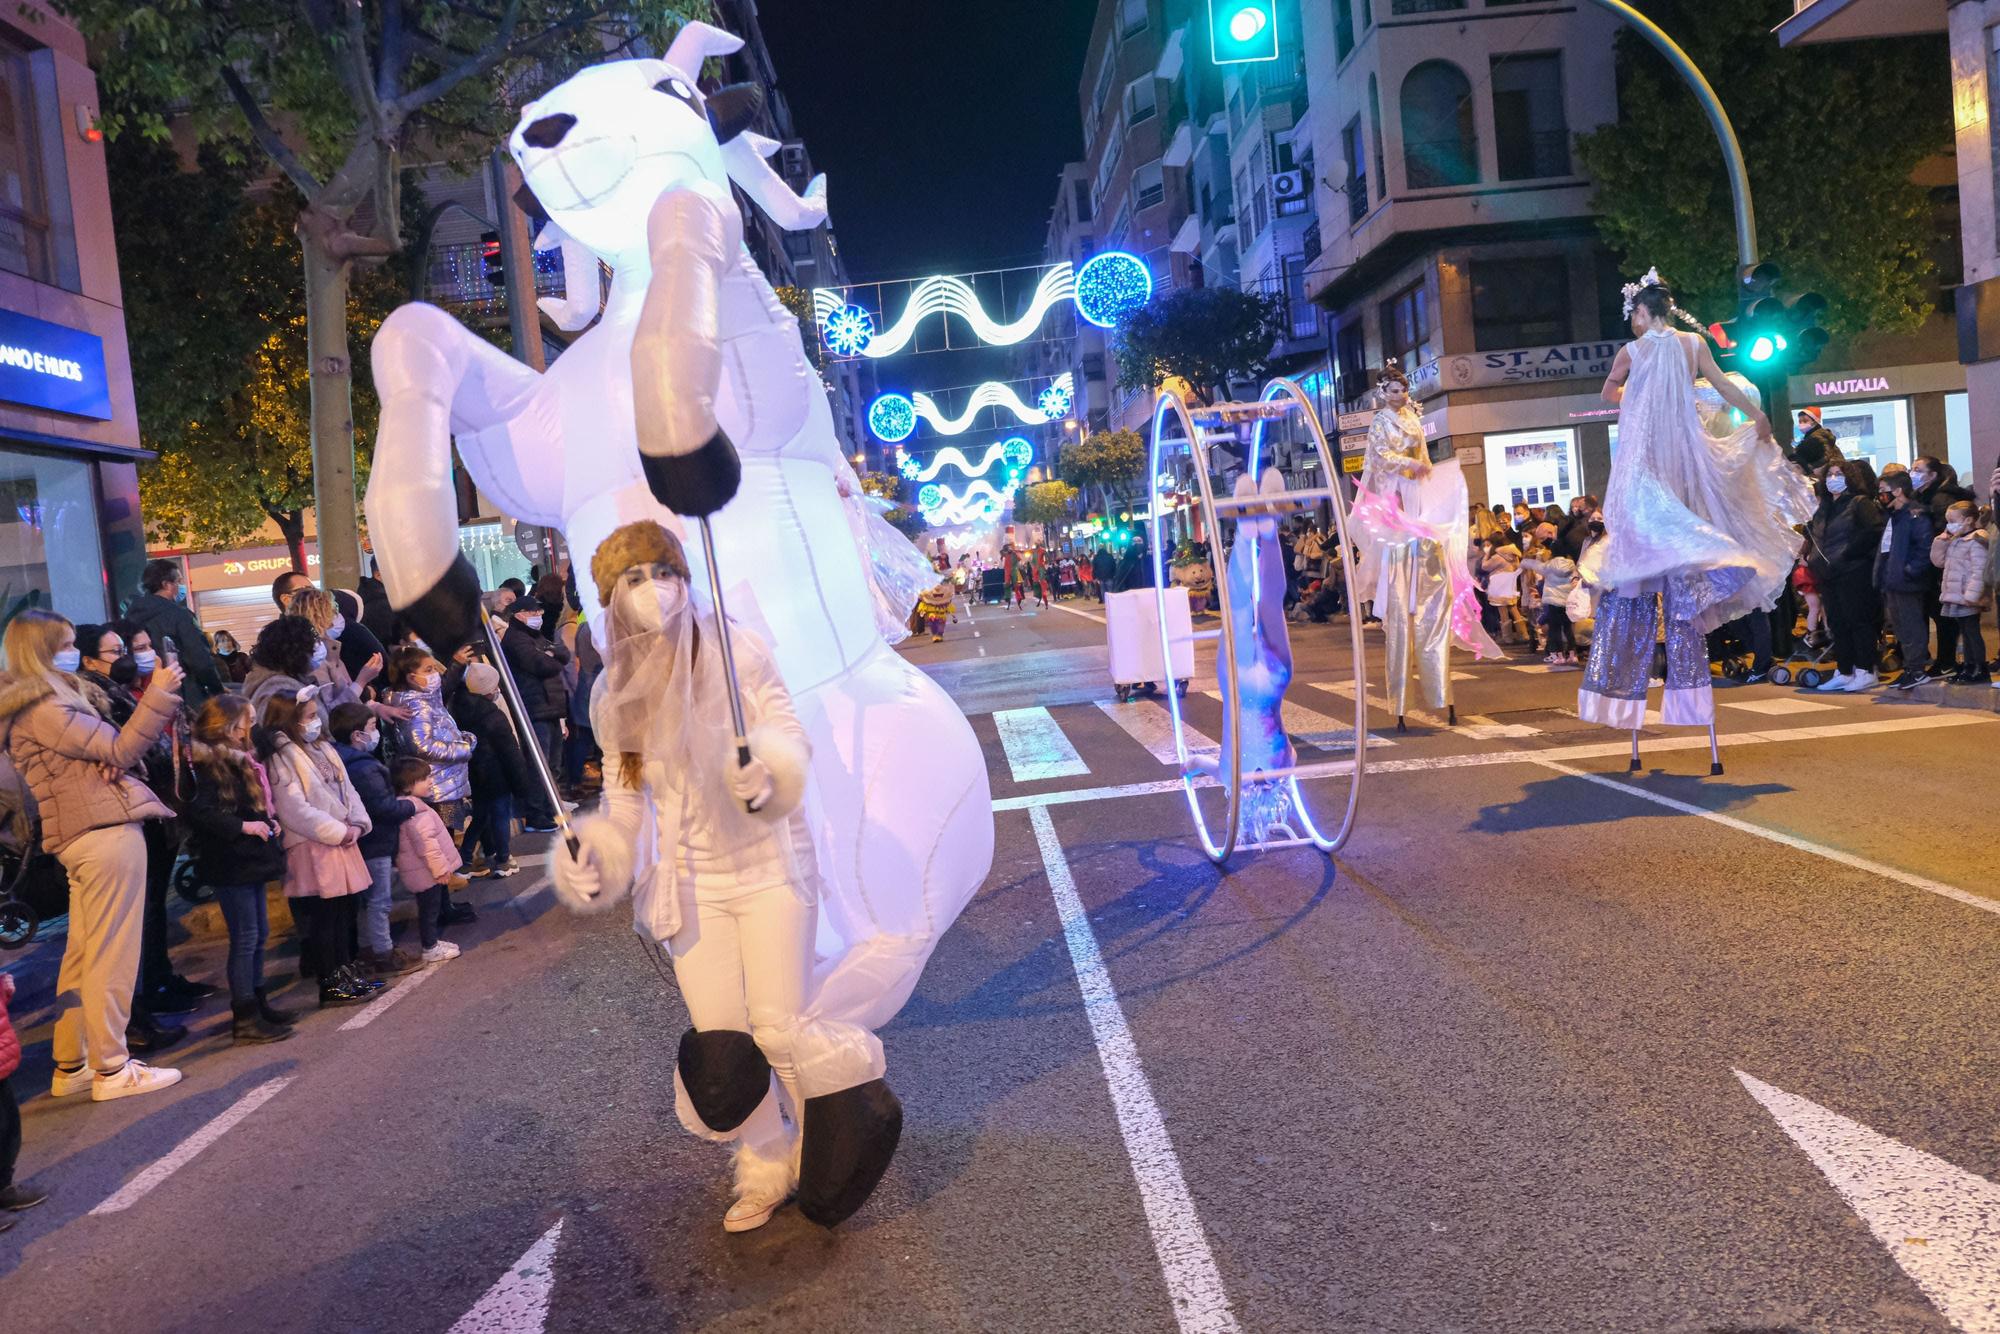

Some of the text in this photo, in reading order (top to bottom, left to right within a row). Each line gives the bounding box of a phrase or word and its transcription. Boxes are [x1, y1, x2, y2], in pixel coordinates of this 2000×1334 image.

[1484, 343, 1626, 368] ST. AND
[44, 354, 83, 381] HIJOS
[1502, 361, 1608, 380] School of
[1814, 377, 1890, 396] NAUTALIA
[247, 556, 293, 573] GRUPO
